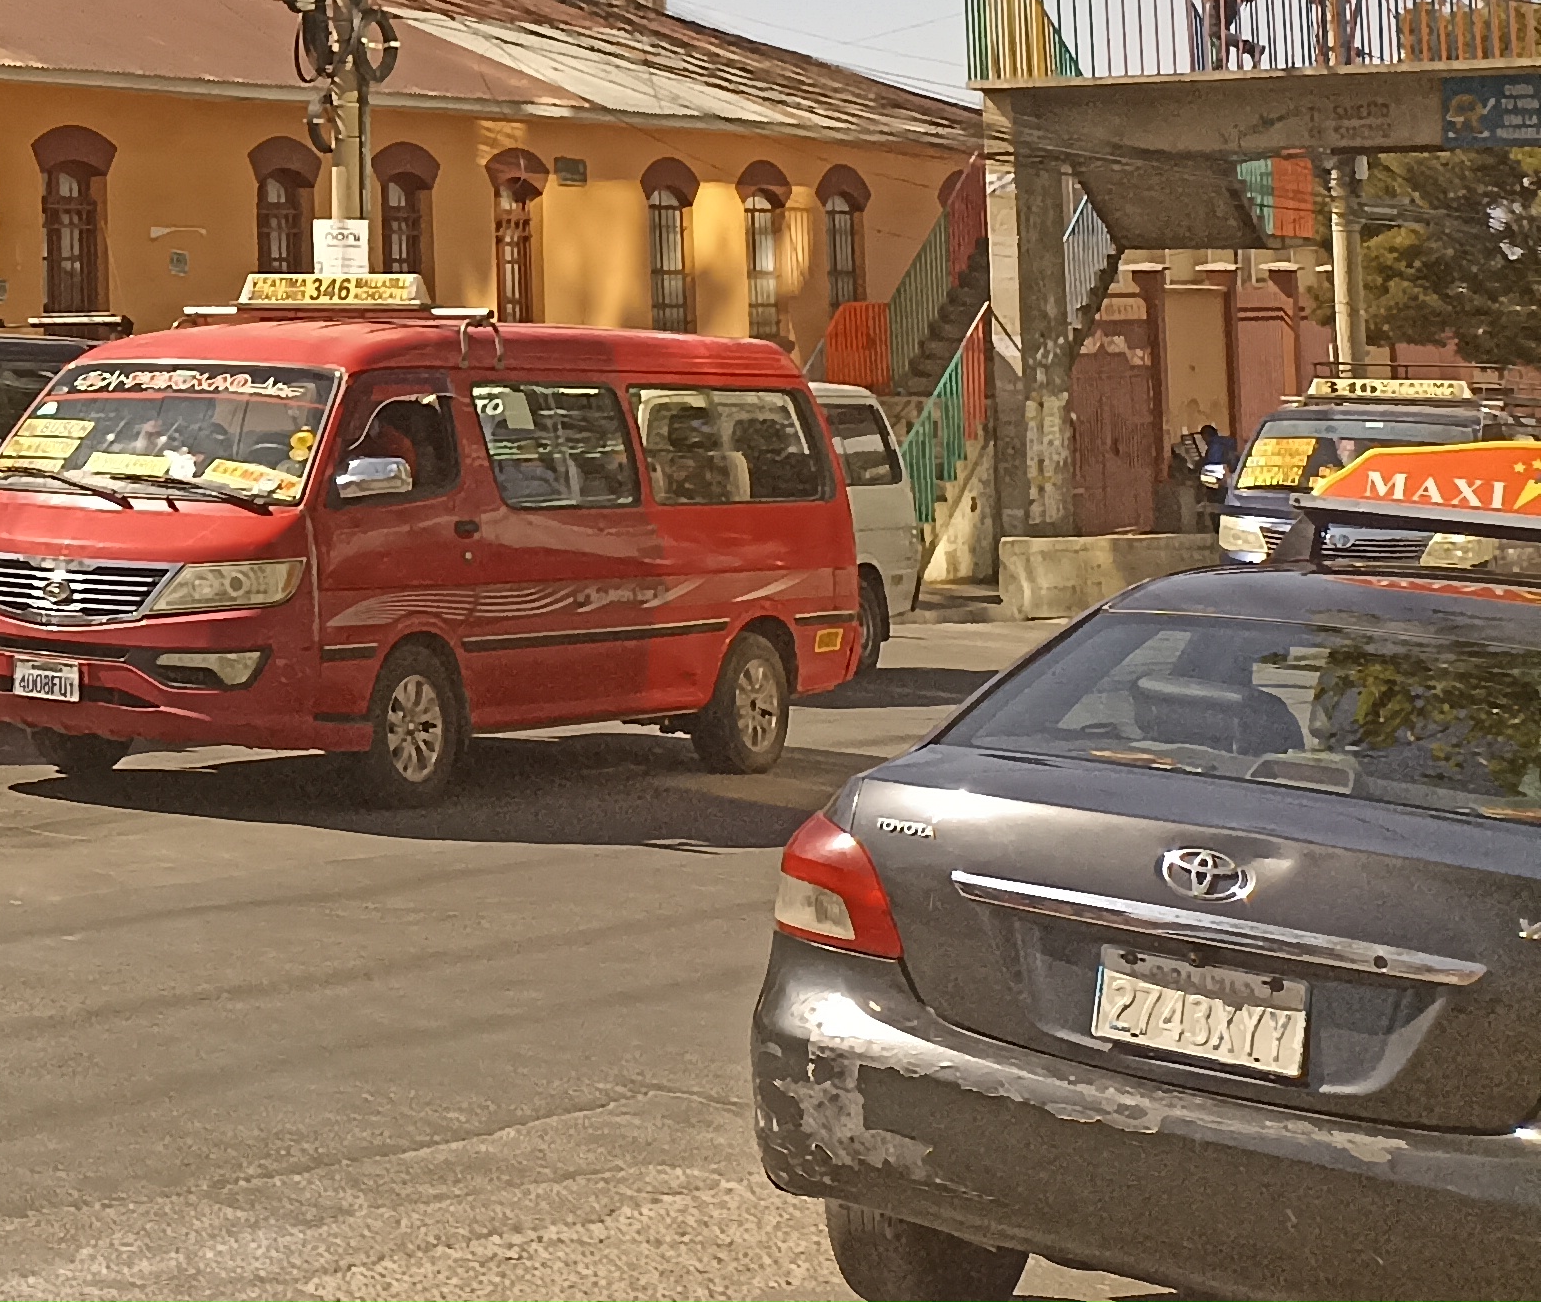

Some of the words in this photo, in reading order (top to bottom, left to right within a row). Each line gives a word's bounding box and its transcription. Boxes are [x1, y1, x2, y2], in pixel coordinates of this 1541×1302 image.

[309, 277, 351, 301] 346
[1325, 380, 1378, 394] 346
[1365, 470, 1507, 509] MAXI
[877, 817, 935, 838] TOYOTA
[1108, 979, 1292, 1063] 2743XYY
